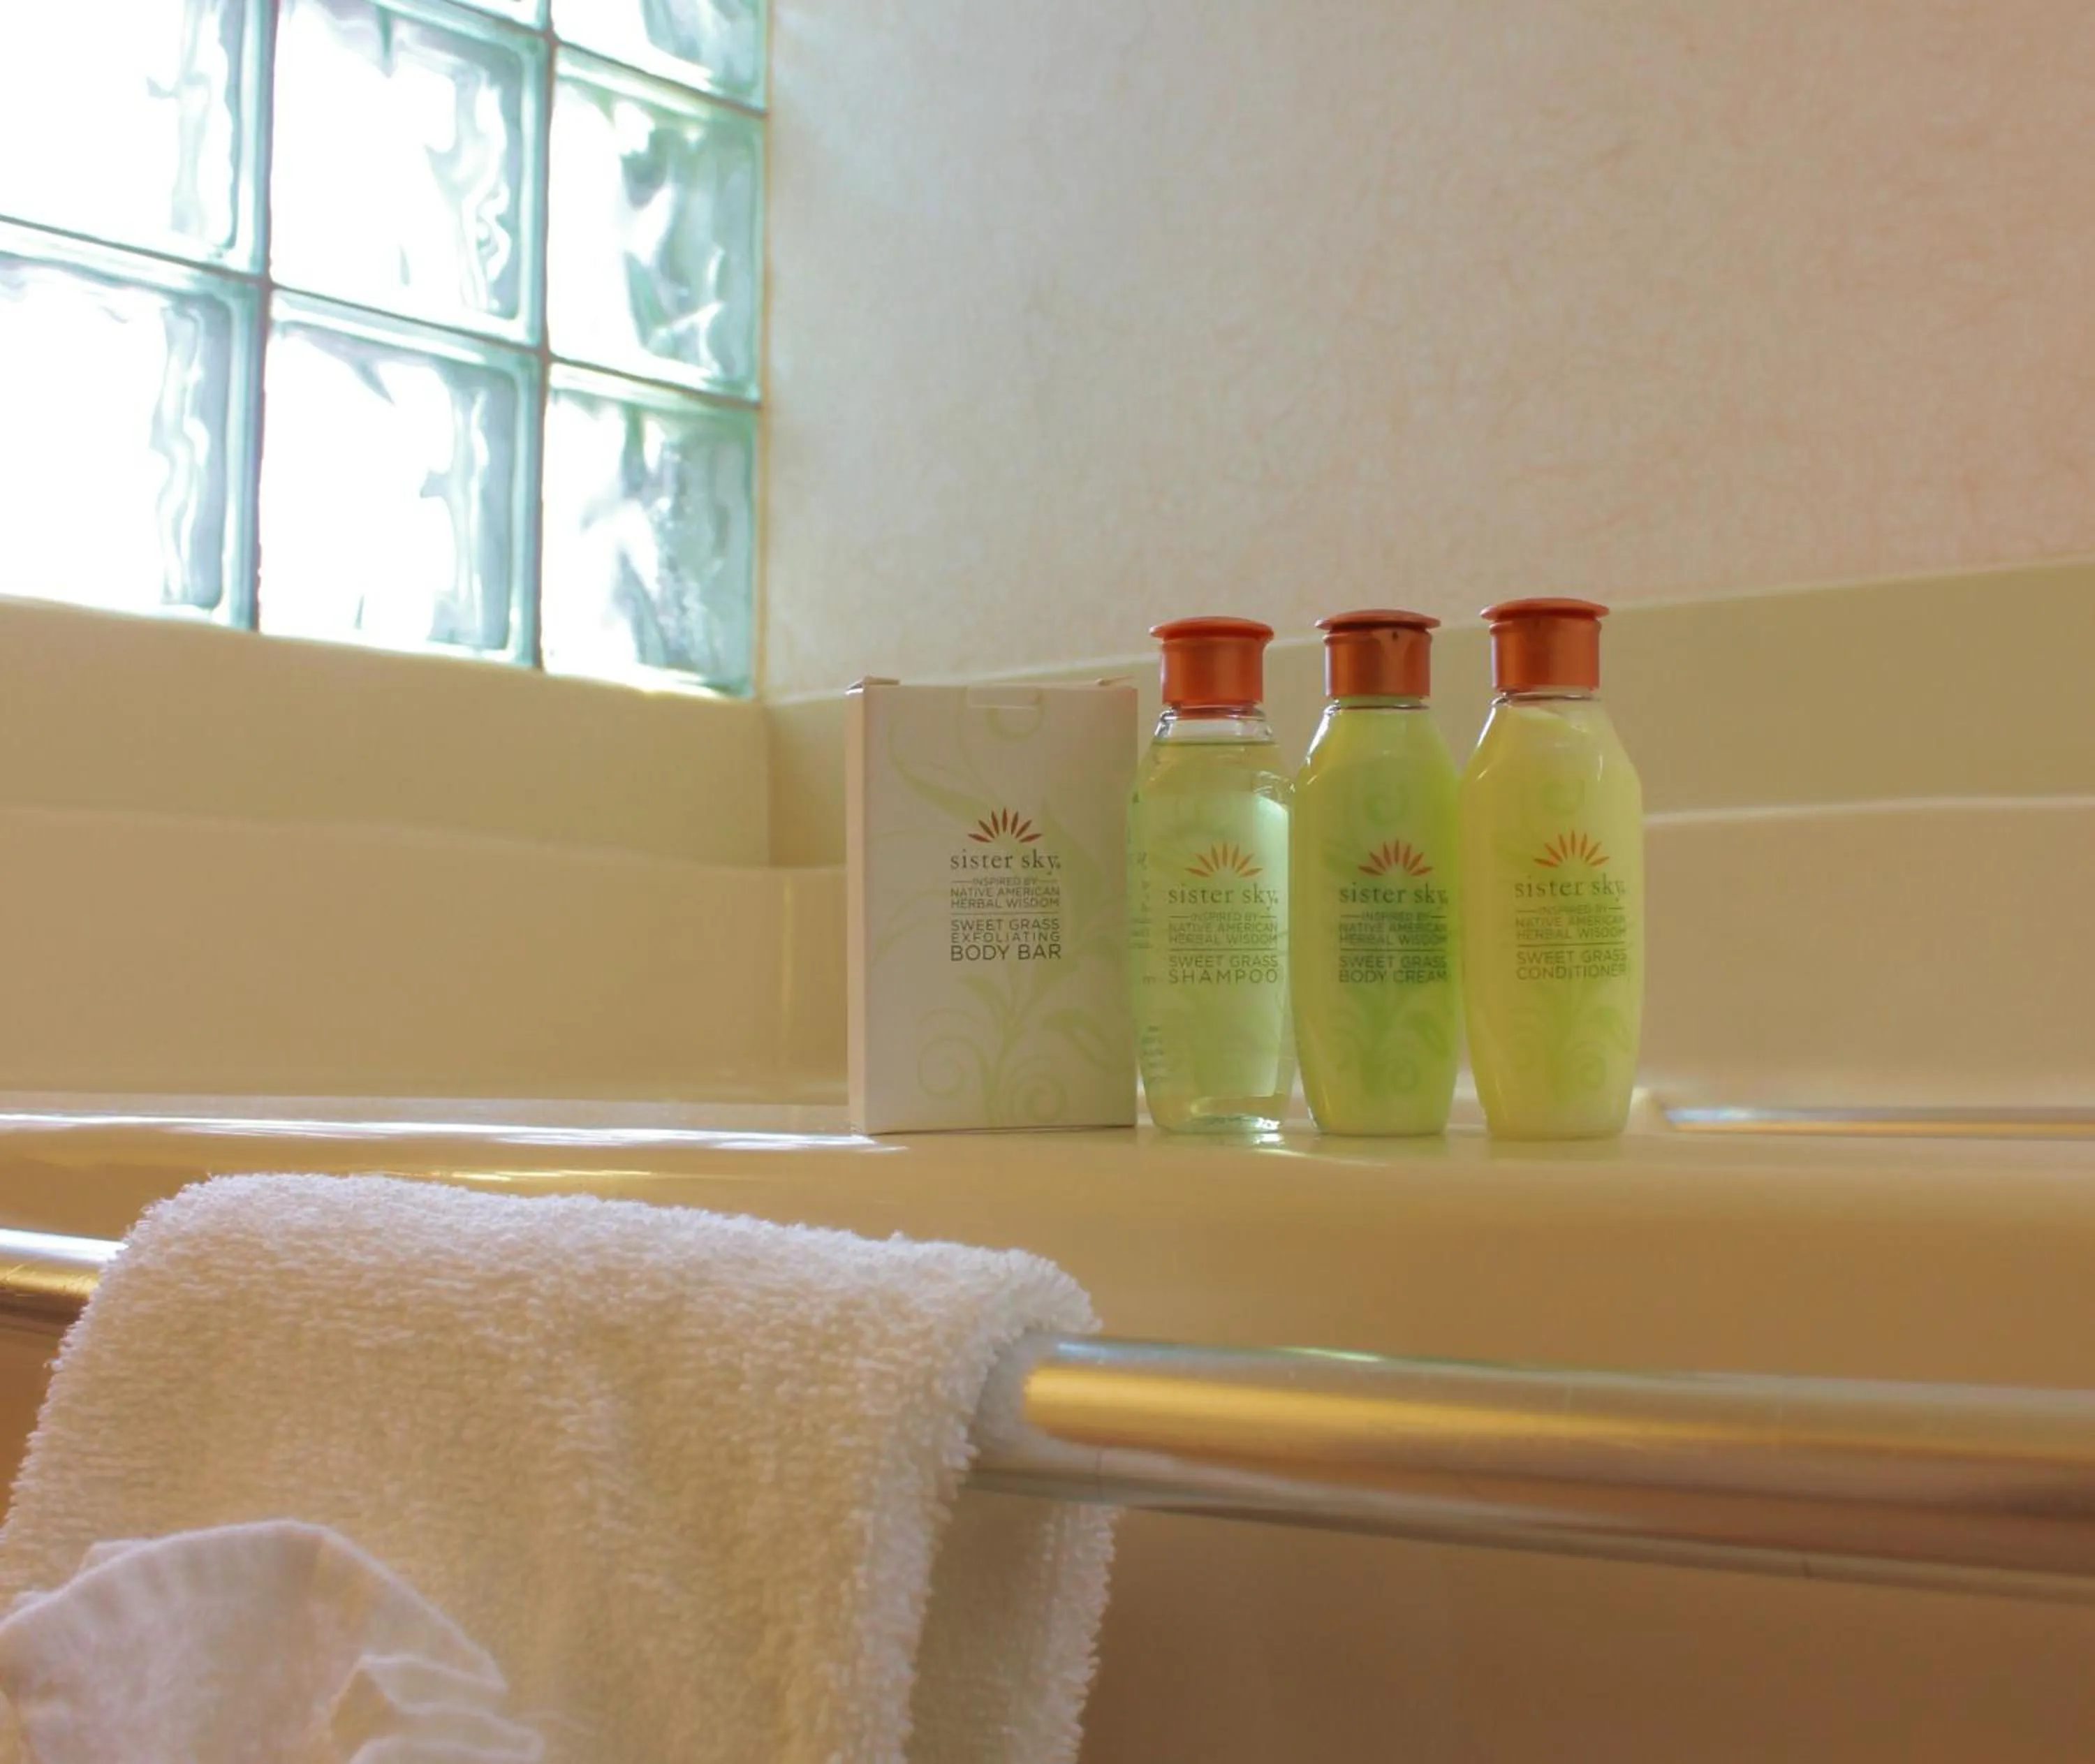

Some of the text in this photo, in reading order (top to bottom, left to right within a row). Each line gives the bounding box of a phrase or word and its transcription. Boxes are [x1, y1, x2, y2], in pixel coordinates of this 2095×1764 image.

[950, 848, 1013, 869] sister
[973, 876, 1037, 886] INSPIRED BY
[1515, 875, 1584, 898] sister
[950, 885, 1060, 897] NATIVE AMERICAN
[1168, 883, 1234, 904] sister
[1339, 882, 1406, 904] sister
[950, 897, 1059, 909] HERBAL WISDOM
[950, 918, 1059, 931] SWEET GRASS
[1217, 922, 1277, 932] AMERICAN
[950, 932, 1059, 943] EXFOLIATING
[1226, 932, 1277, 943] WISDOM
[950, 944, 1061, 961] BODY BAR
[1516, 948, 1627, 965] SWEET GRASS
[1168, 955, 1278, 968] SWEET GRASS
[1339, 955, 1448, 969] SWEET GRASS
[1168, 969, 1278, 984] SHAMPOO
[1339, 969, 1448, 983] BODY CREAM
[1516, 964, 1627, 980] CONDITIONER
